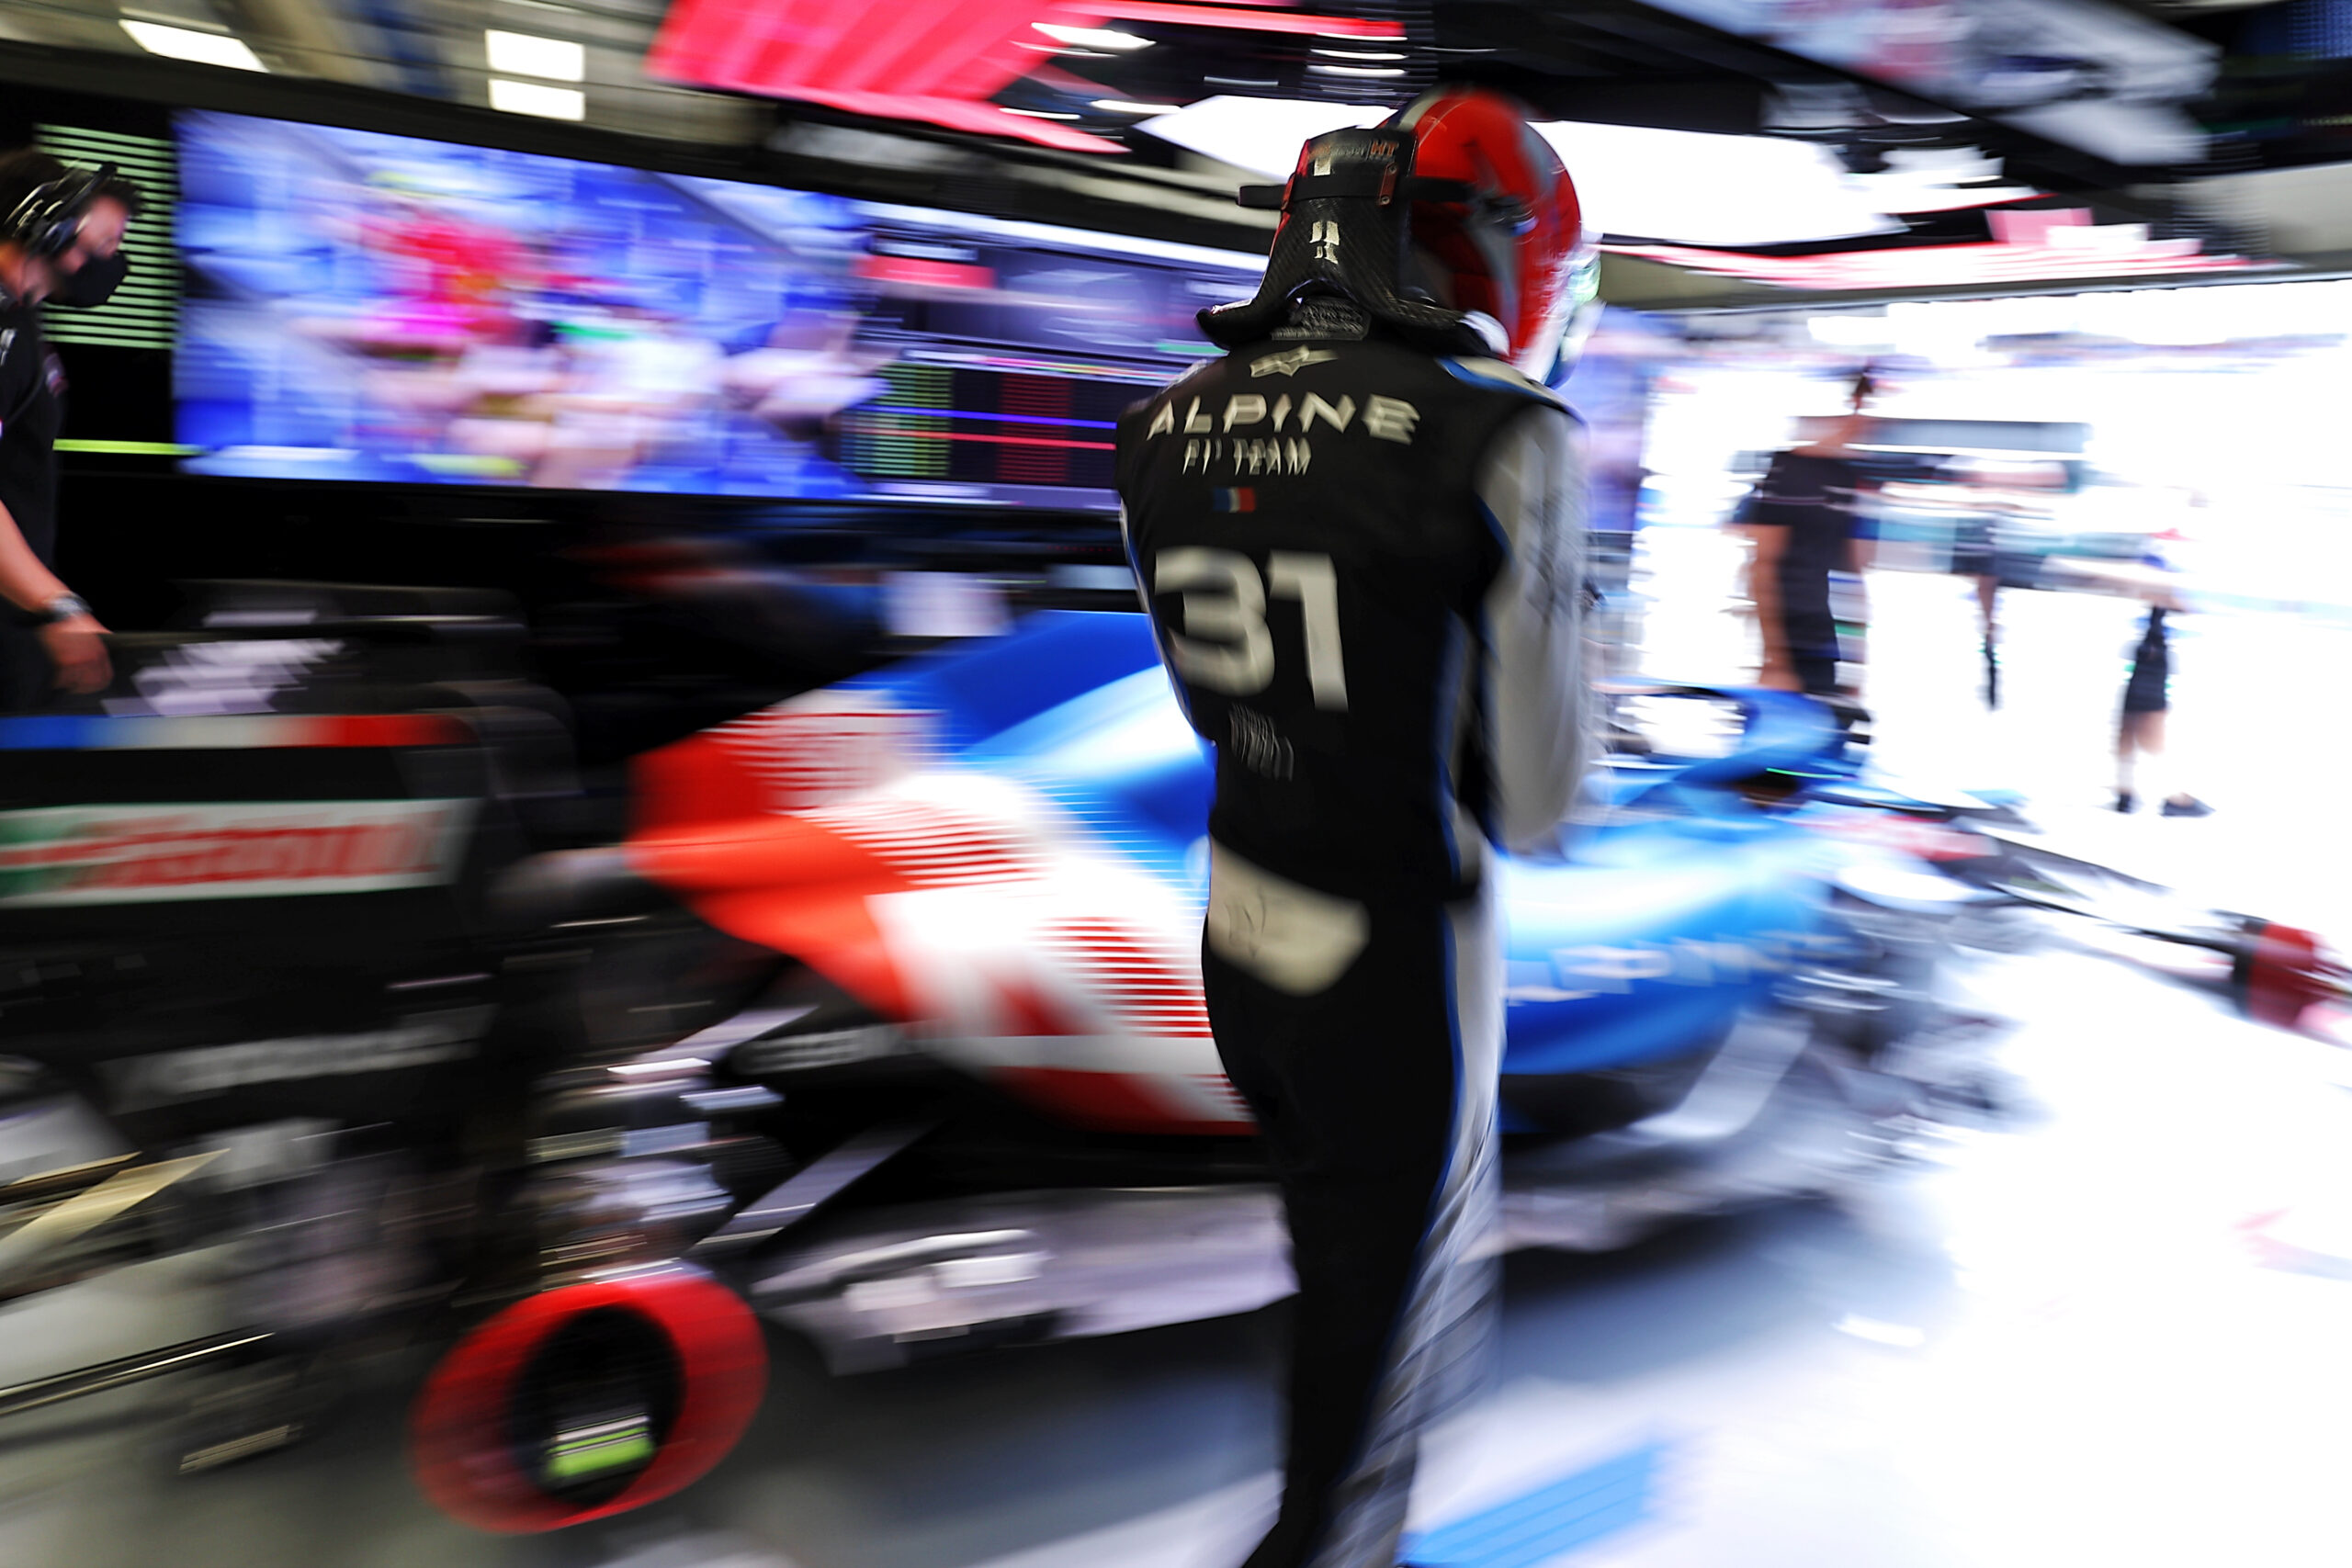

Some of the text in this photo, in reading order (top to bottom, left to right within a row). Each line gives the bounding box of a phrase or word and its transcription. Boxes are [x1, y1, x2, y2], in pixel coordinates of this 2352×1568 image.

[1146, 390, 1420, 445] ALPINE
[1233, 435, 1312, 476] TEAM
[1154, 546, 1349, 713] 31
